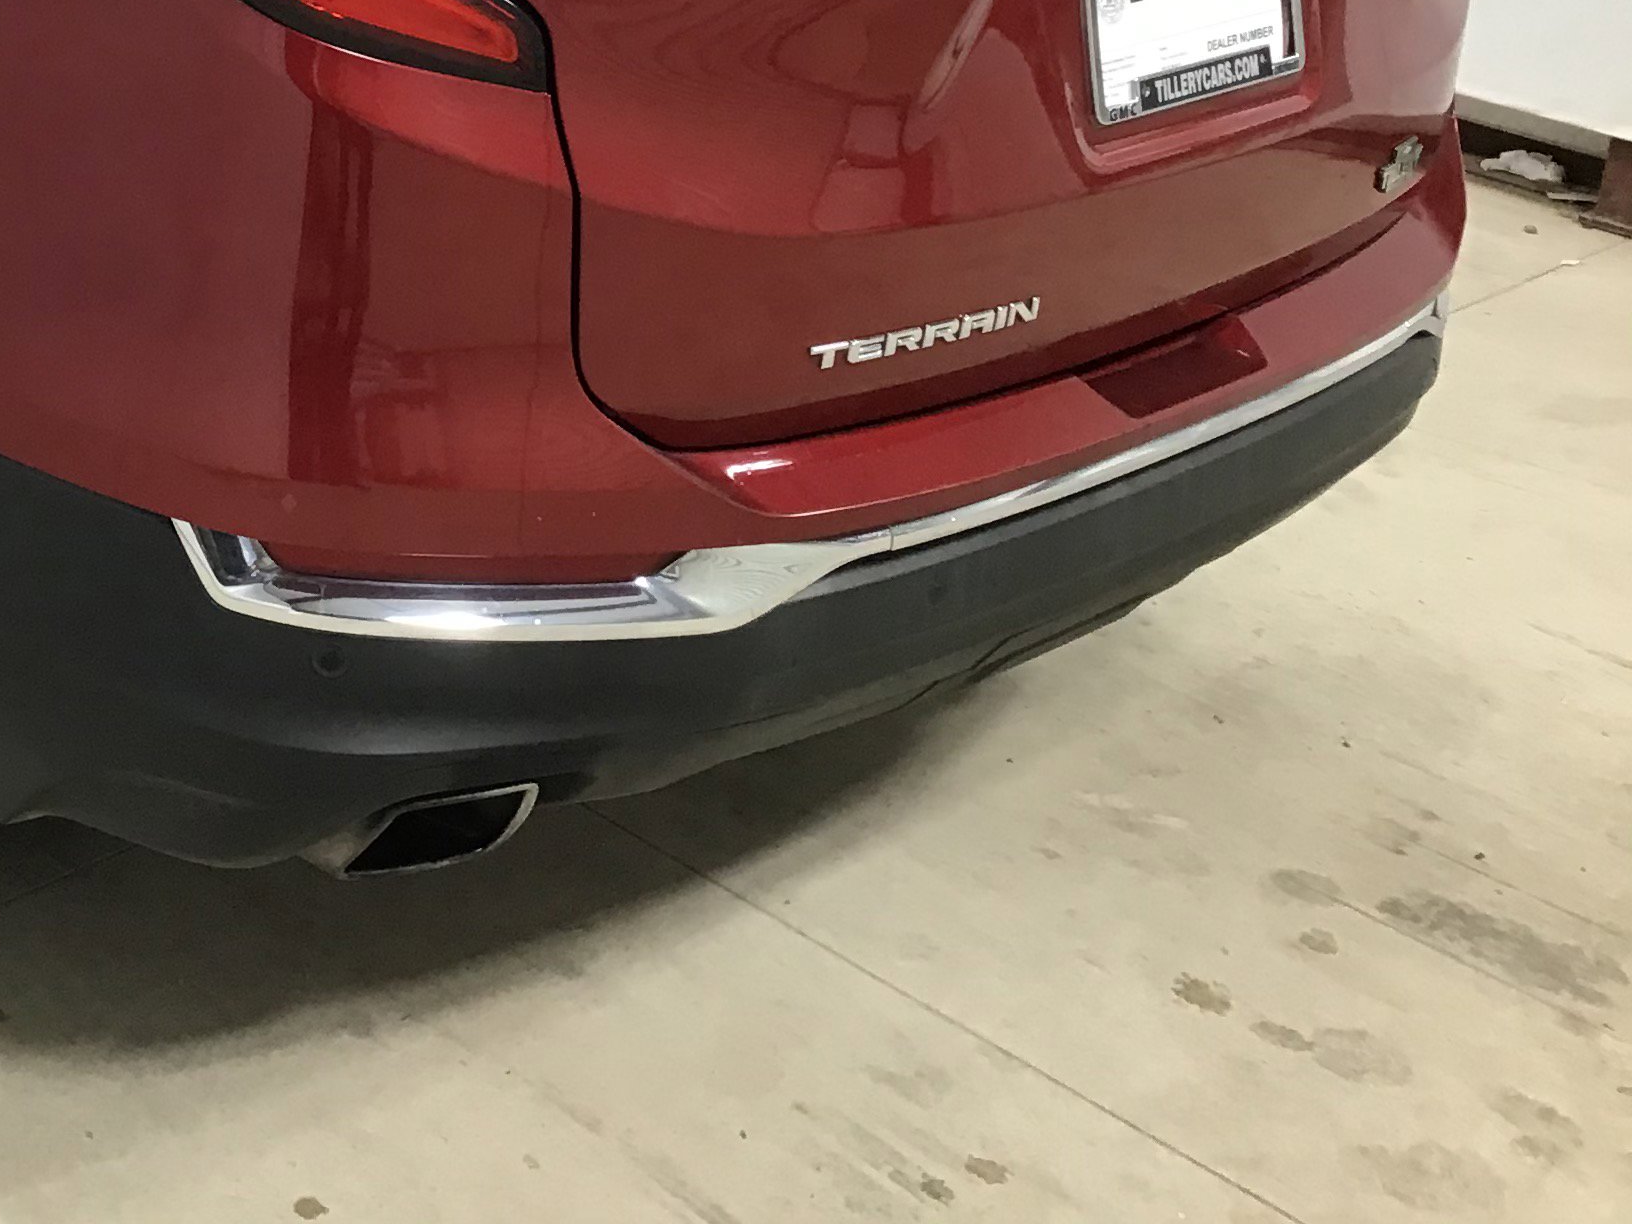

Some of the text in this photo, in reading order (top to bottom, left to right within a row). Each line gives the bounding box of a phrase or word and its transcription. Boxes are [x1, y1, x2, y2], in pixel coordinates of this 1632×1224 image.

[1206, 25, 1274, 53] DEALER NUMBER
[1154, 53, 1261, 104] TILLERYCARS.COM
[810, 296, 1041, 370] TERRAIN
